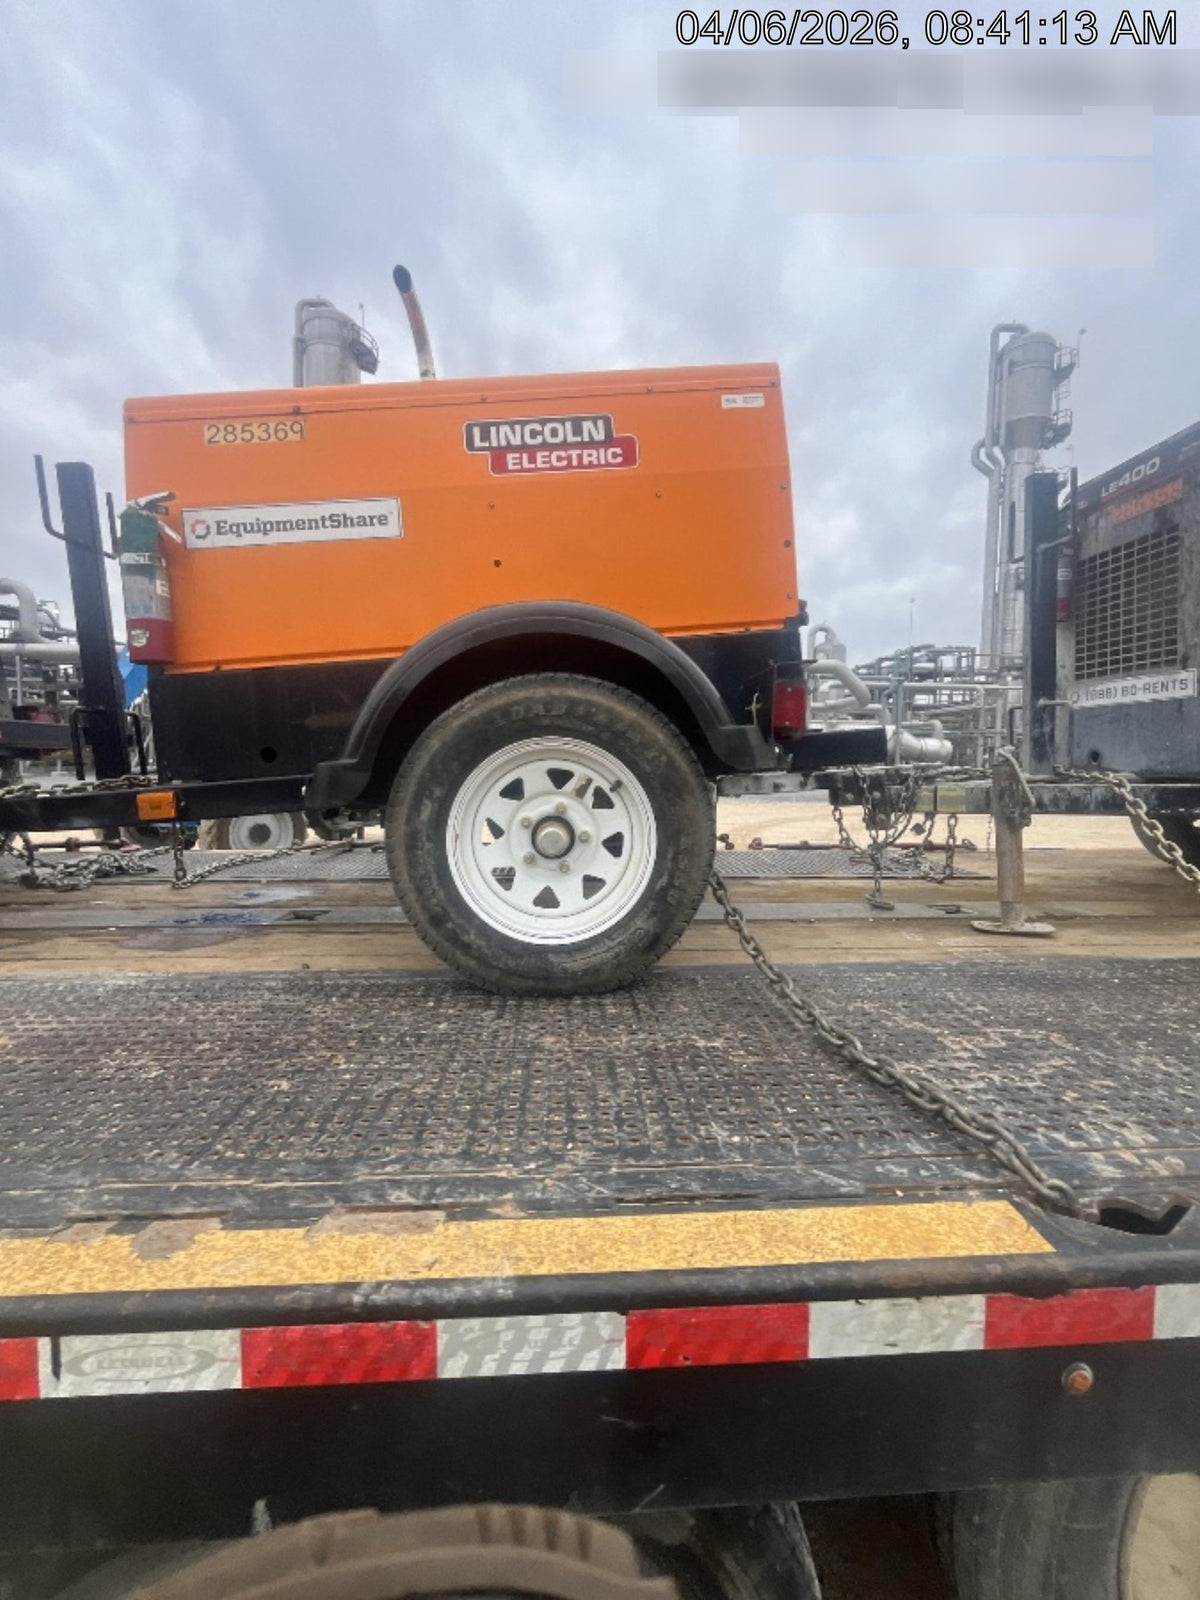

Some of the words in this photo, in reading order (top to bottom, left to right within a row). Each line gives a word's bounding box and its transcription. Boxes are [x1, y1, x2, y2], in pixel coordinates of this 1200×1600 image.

[206, 421, 305, 444] 285369
[472, 418, 606, 448] LINCOLN
[506, 447, 623, 470] ELECTRIC
[1102, 456, 1160, 497] LE400
[215, 512, 389, 537] EquipmentShare
